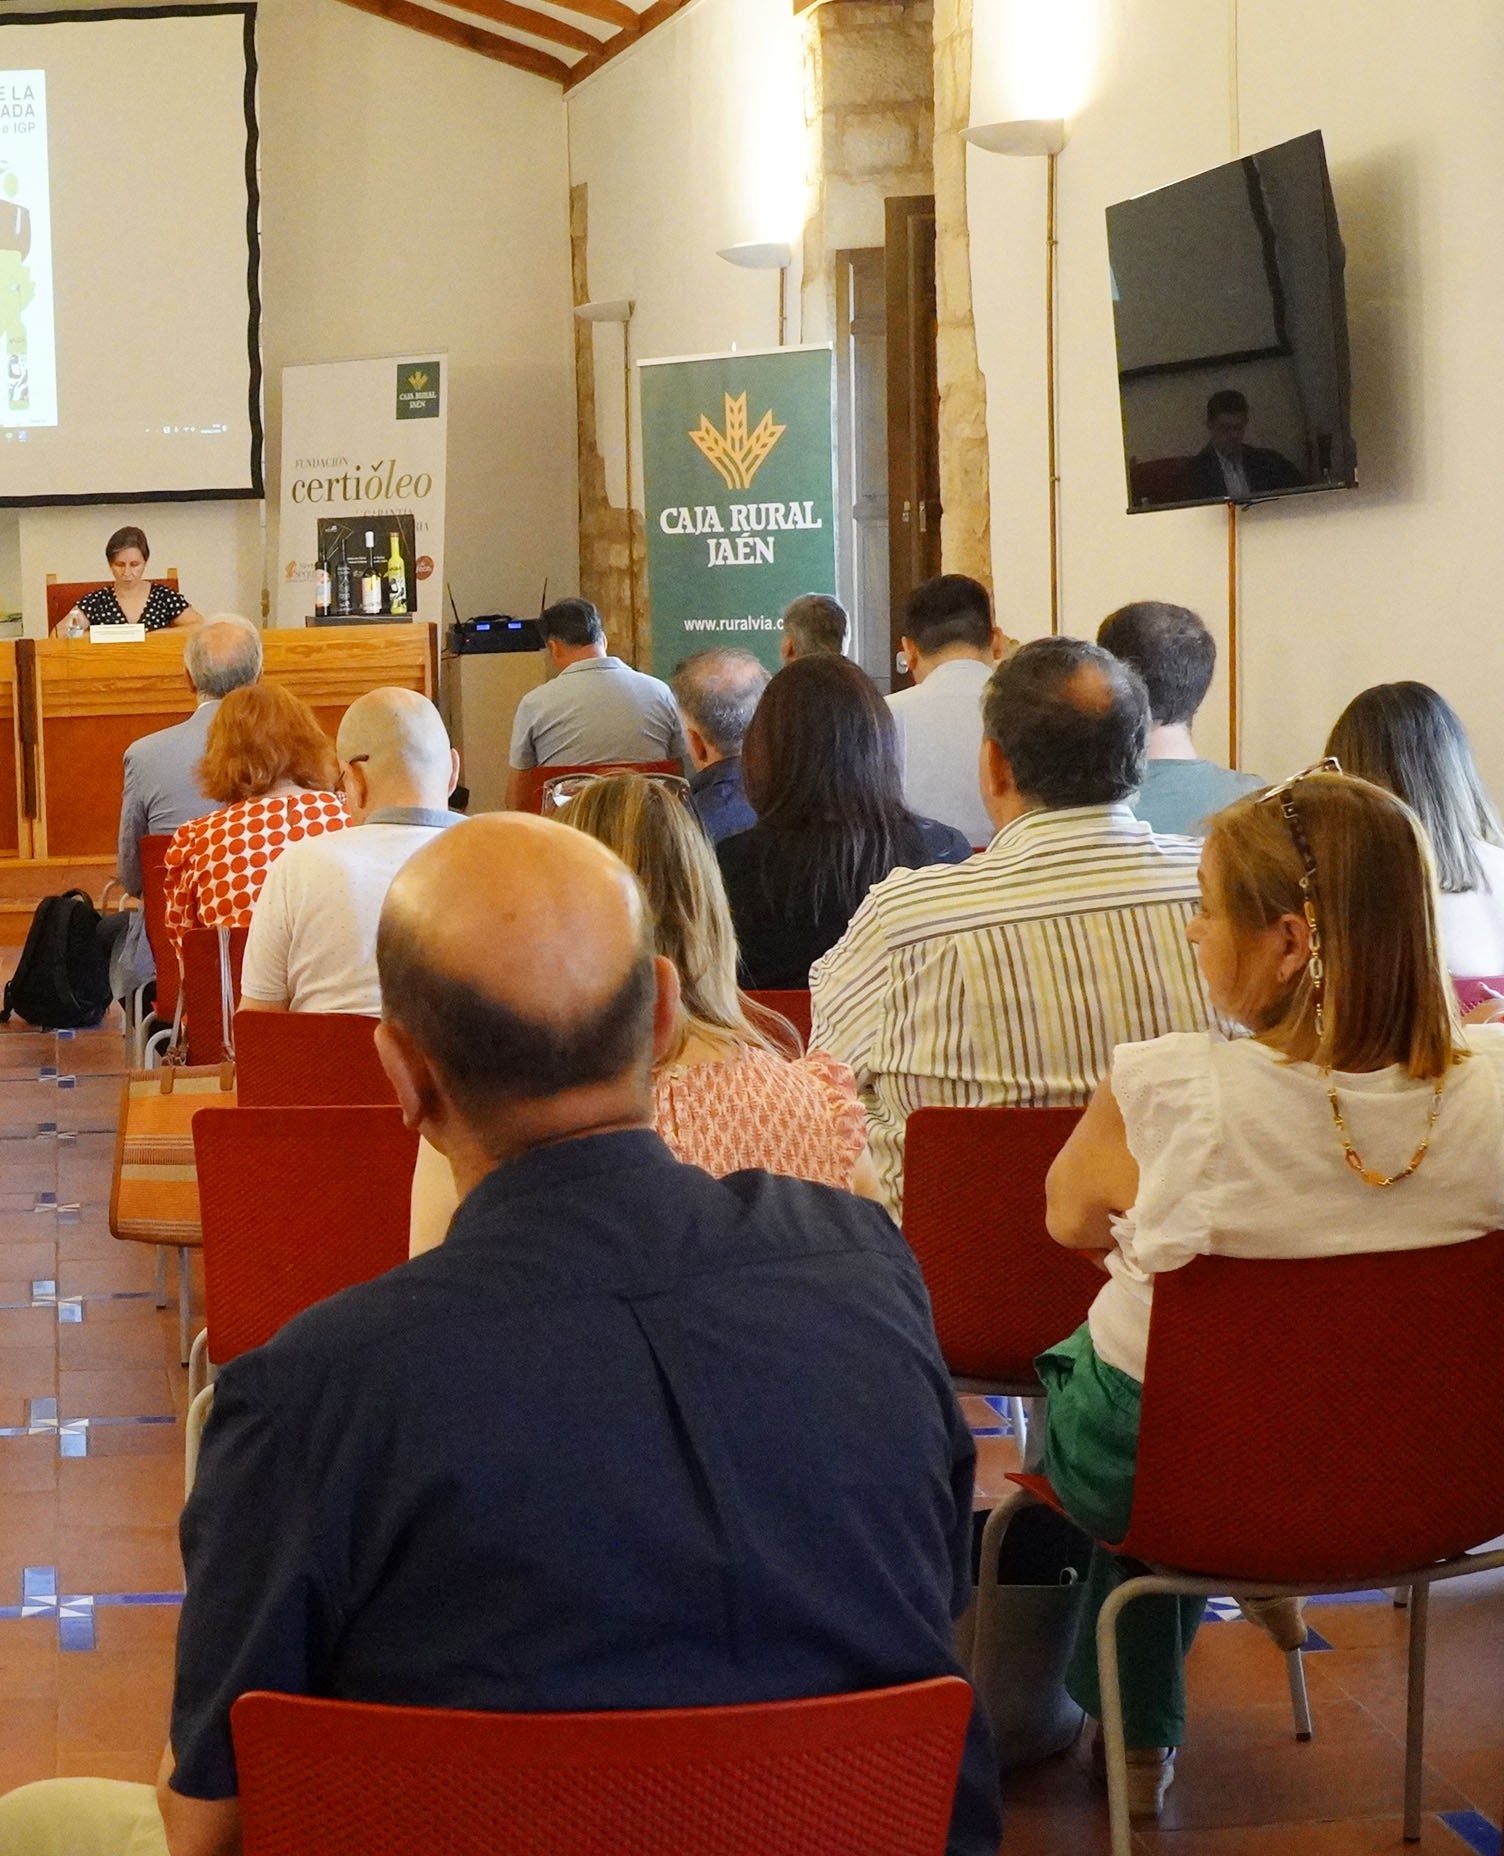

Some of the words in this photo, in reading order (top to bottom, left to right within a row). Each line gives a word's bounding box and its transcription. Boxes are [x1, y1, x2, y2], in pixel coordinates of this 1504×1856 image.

[12, 85, 35, 101] LA
[13, 122, 36, 134] IGP
[659, 504, 724, 535] CAJA
[730, 501, 822, 533] RURAL
[707, 532, 775, 568] JAÉN
[684, 614, 784, 632] www.ruralvia.c
